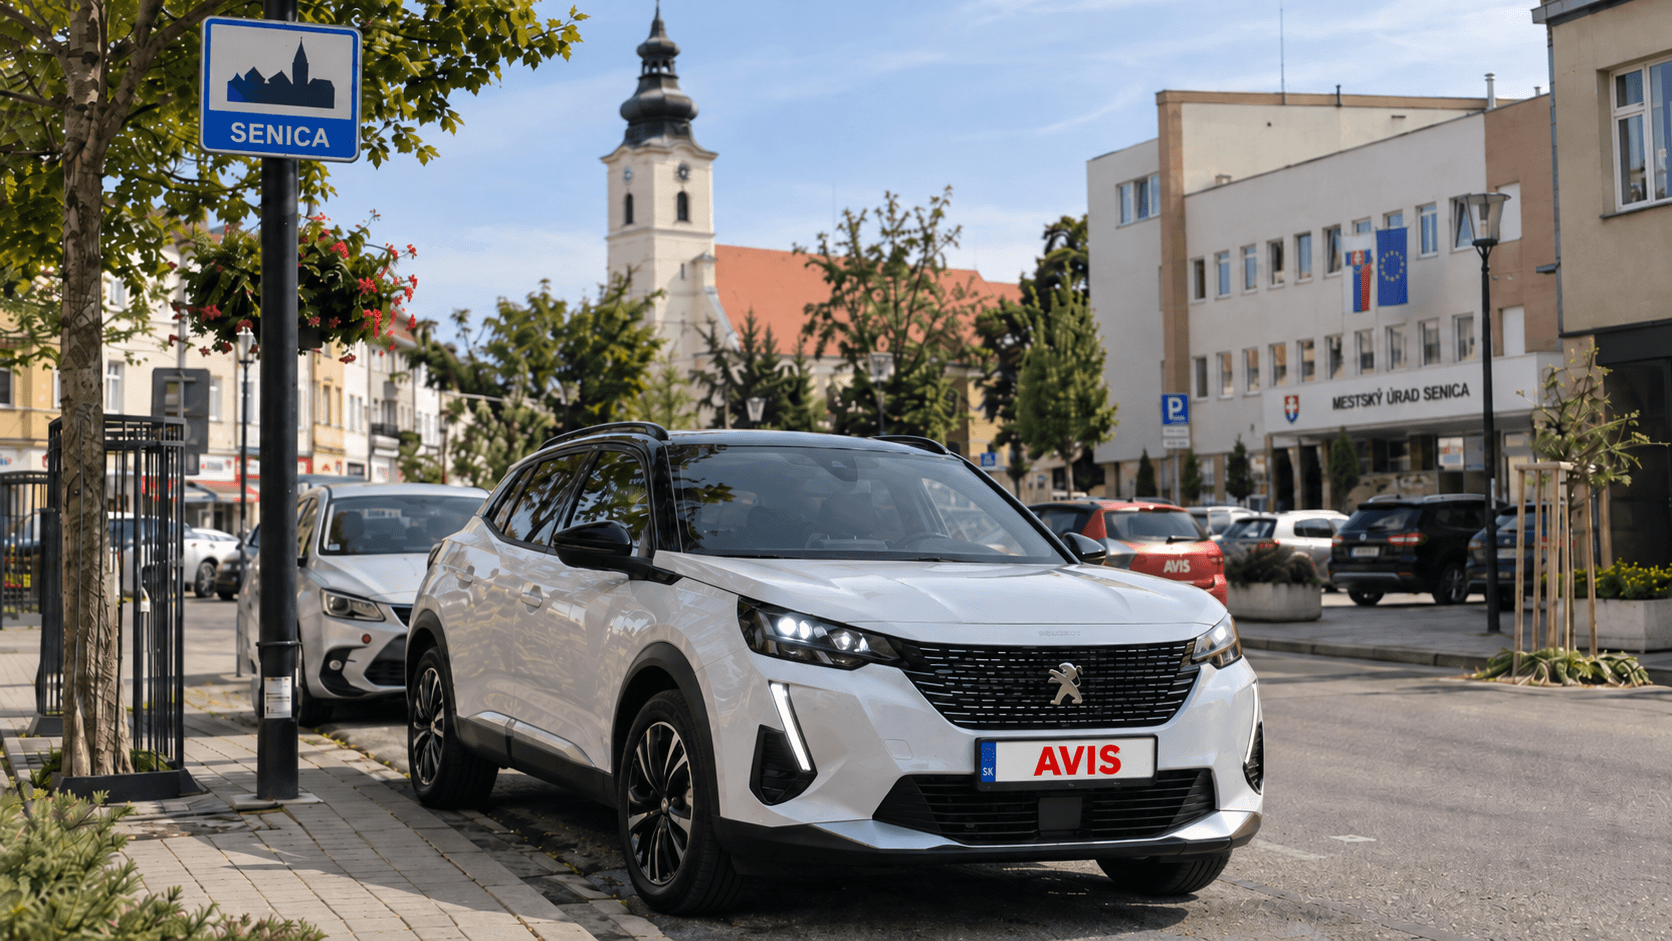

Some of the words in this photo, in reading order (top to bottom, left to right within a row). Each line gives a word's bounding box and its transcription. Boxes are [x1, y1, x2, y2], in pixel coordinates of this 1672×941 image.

[230, 122, 331, 148] SENICA
[1168, 397, 1183, 420] P
[1332, 388, 1383, 410] MESTSKÝ
[1386, 387, 1420, 405] ÚRAD
[1423, 383, 1470, 401] SENICA
[1163, 559, 1191, 573] AVIS
[982, 767, 994, 777] SK
[1033, 744, 1122, 776] AVIS
